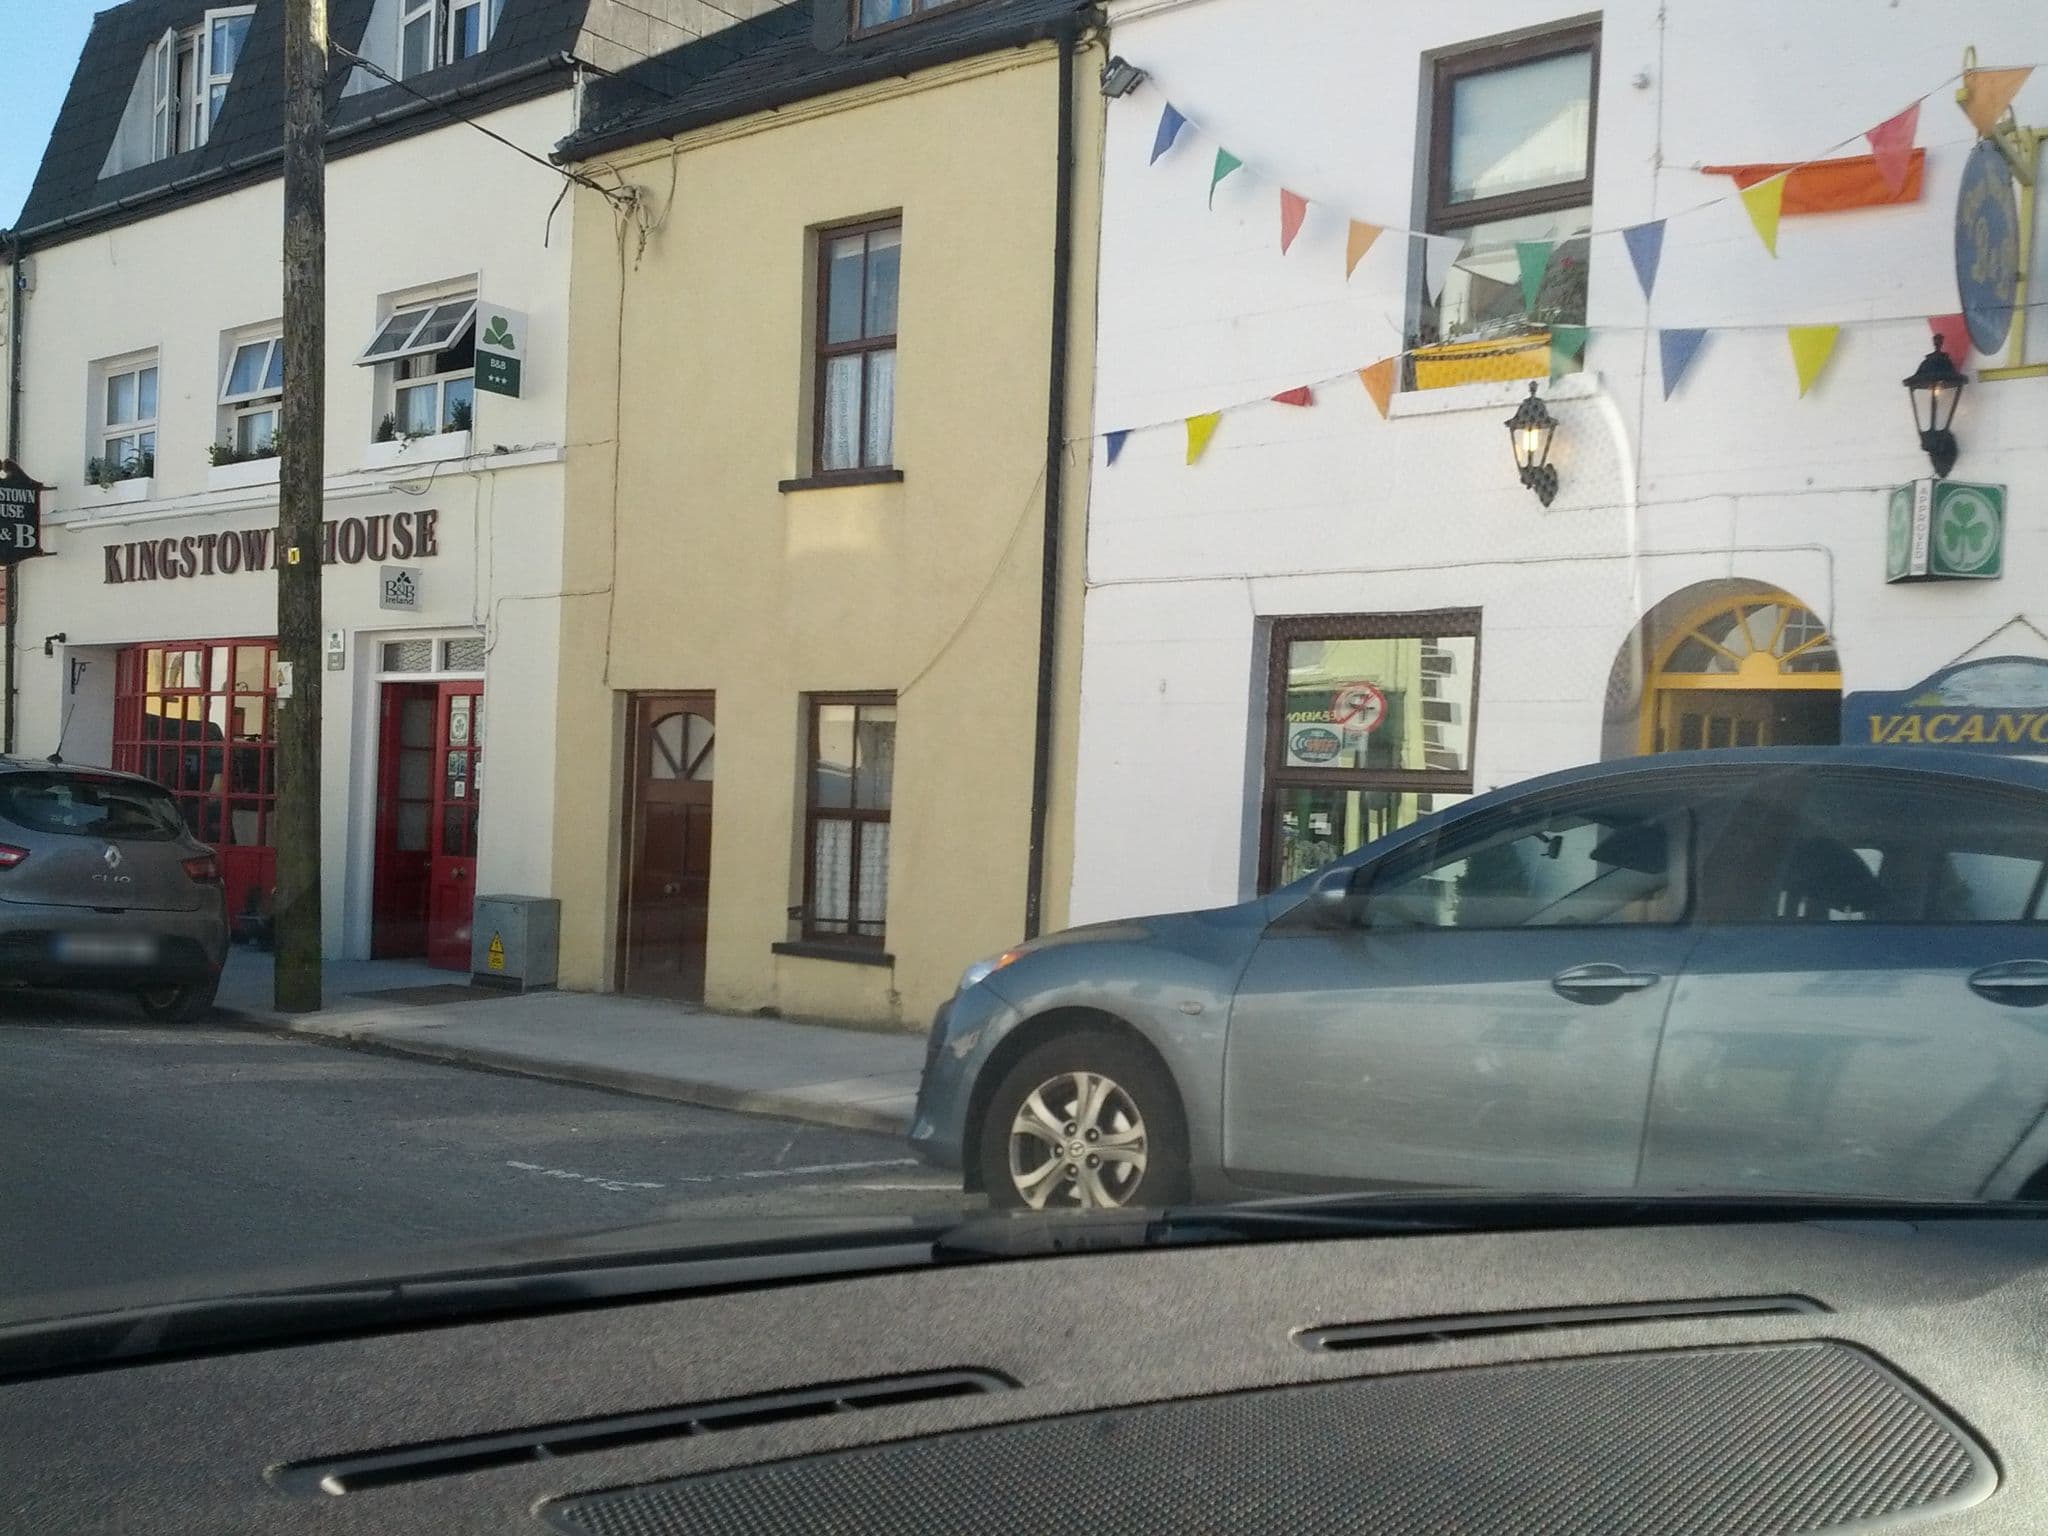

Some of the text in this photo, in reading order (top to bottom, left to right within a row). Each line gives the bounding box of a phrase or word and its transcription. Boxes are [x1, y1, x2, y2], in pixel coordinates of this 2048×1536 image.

[490, 358, 506, 370] B&B
[14, 523, 37, 548] B
[385, 580, 415, 598] B&B
